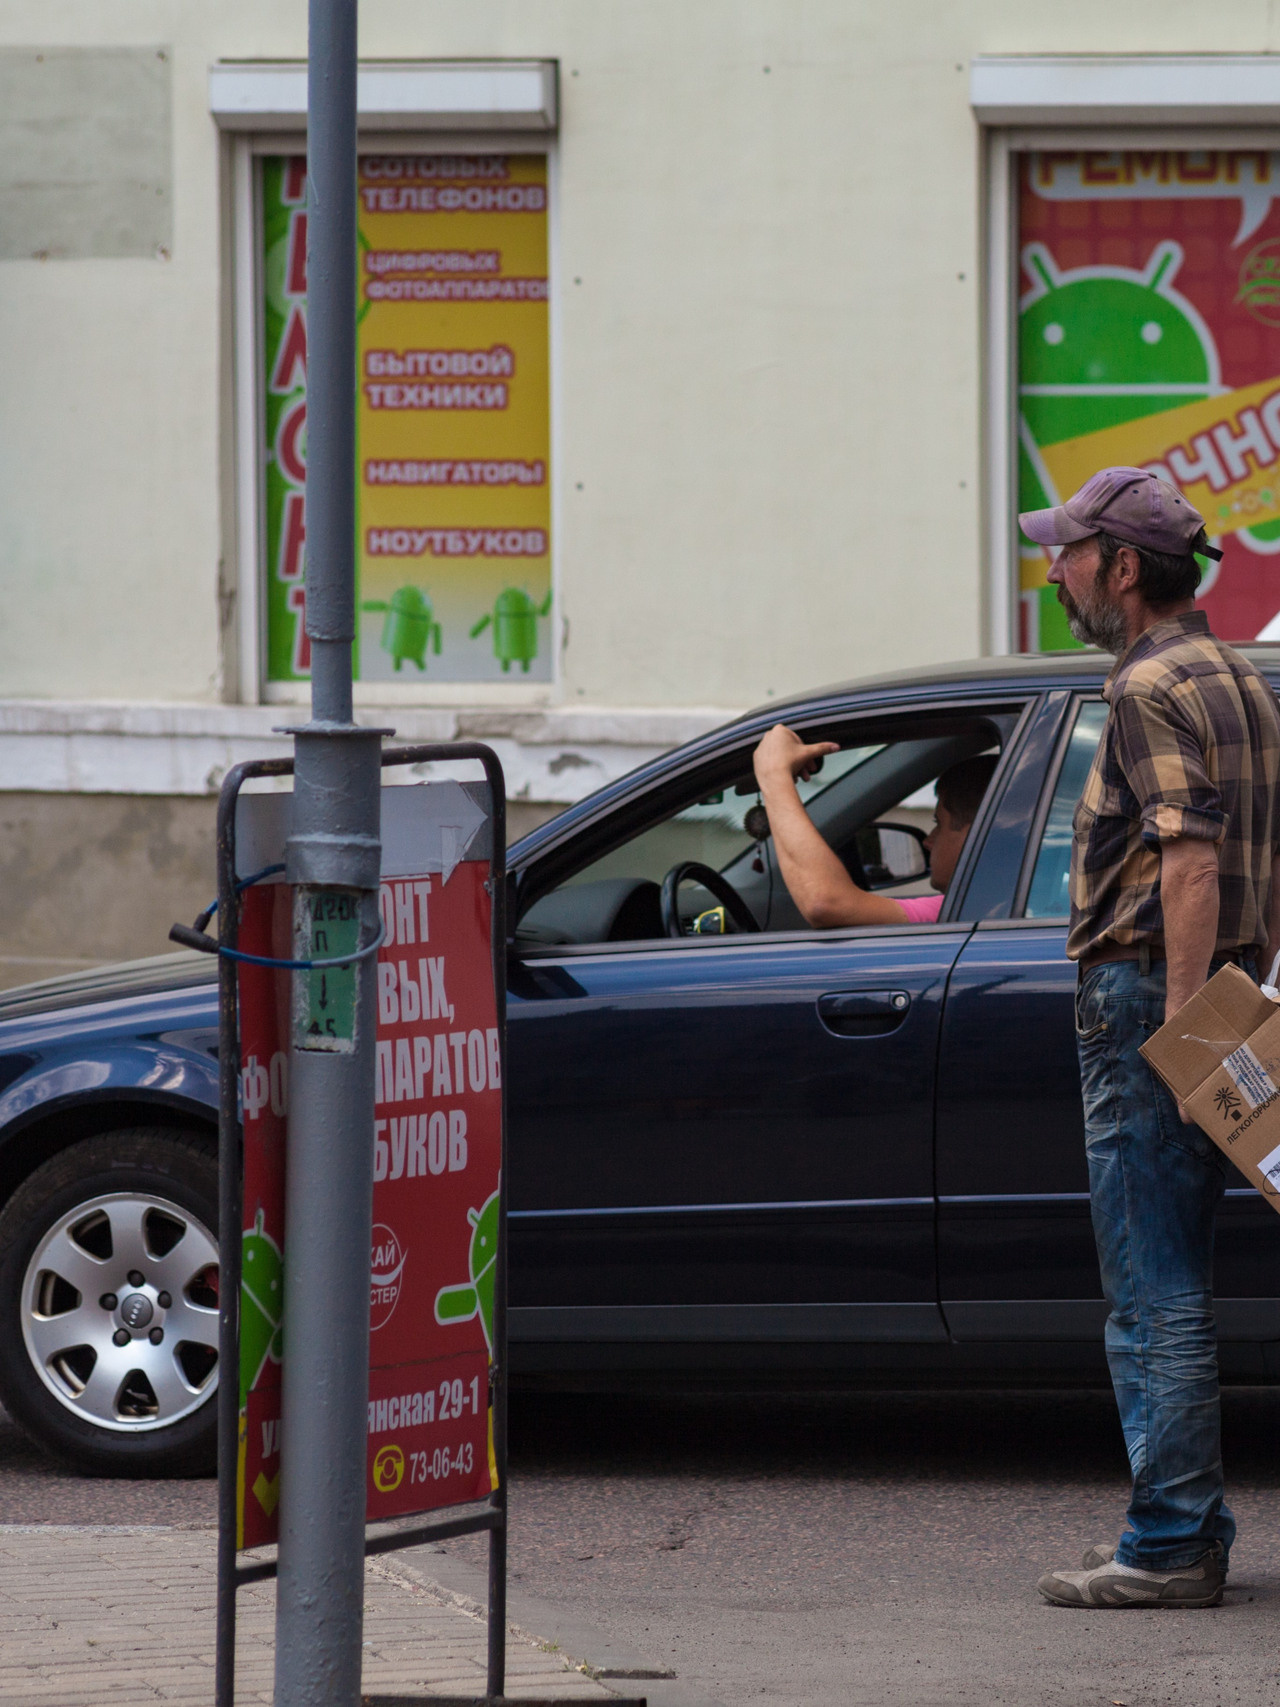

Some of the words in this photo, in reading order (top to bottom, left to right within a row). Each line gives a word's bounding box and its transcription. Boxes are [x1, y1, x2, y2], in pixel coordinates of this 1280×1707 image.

[363, 157, 507, 178] СОТОВЫХ
[363, 187, 545, 211] ТЕЛЕФОНОВ
[366, 252, 499, 274] ЦИФРОВЫХ
[366, 346, 512, 377] БЫТОВОЙ
[366, 385, 506, 409] ТЕХНИКИ
[366, 461, 544, 485] НАВИГАТОРЫ
[368, 530, 546, 555] НОУТБУКОВ
[379, 881, 432, 948] ОНТ
[377, 956, 455, 1025] ВЫХ,
[374, 1028, 501, 1104] ПАРАТОВ
[373, 1109, 468, 1183] БУКОВ
[439, 1375, 479, 1422] 29-1
[409, 1442, 474, 1485] 73-06-43
